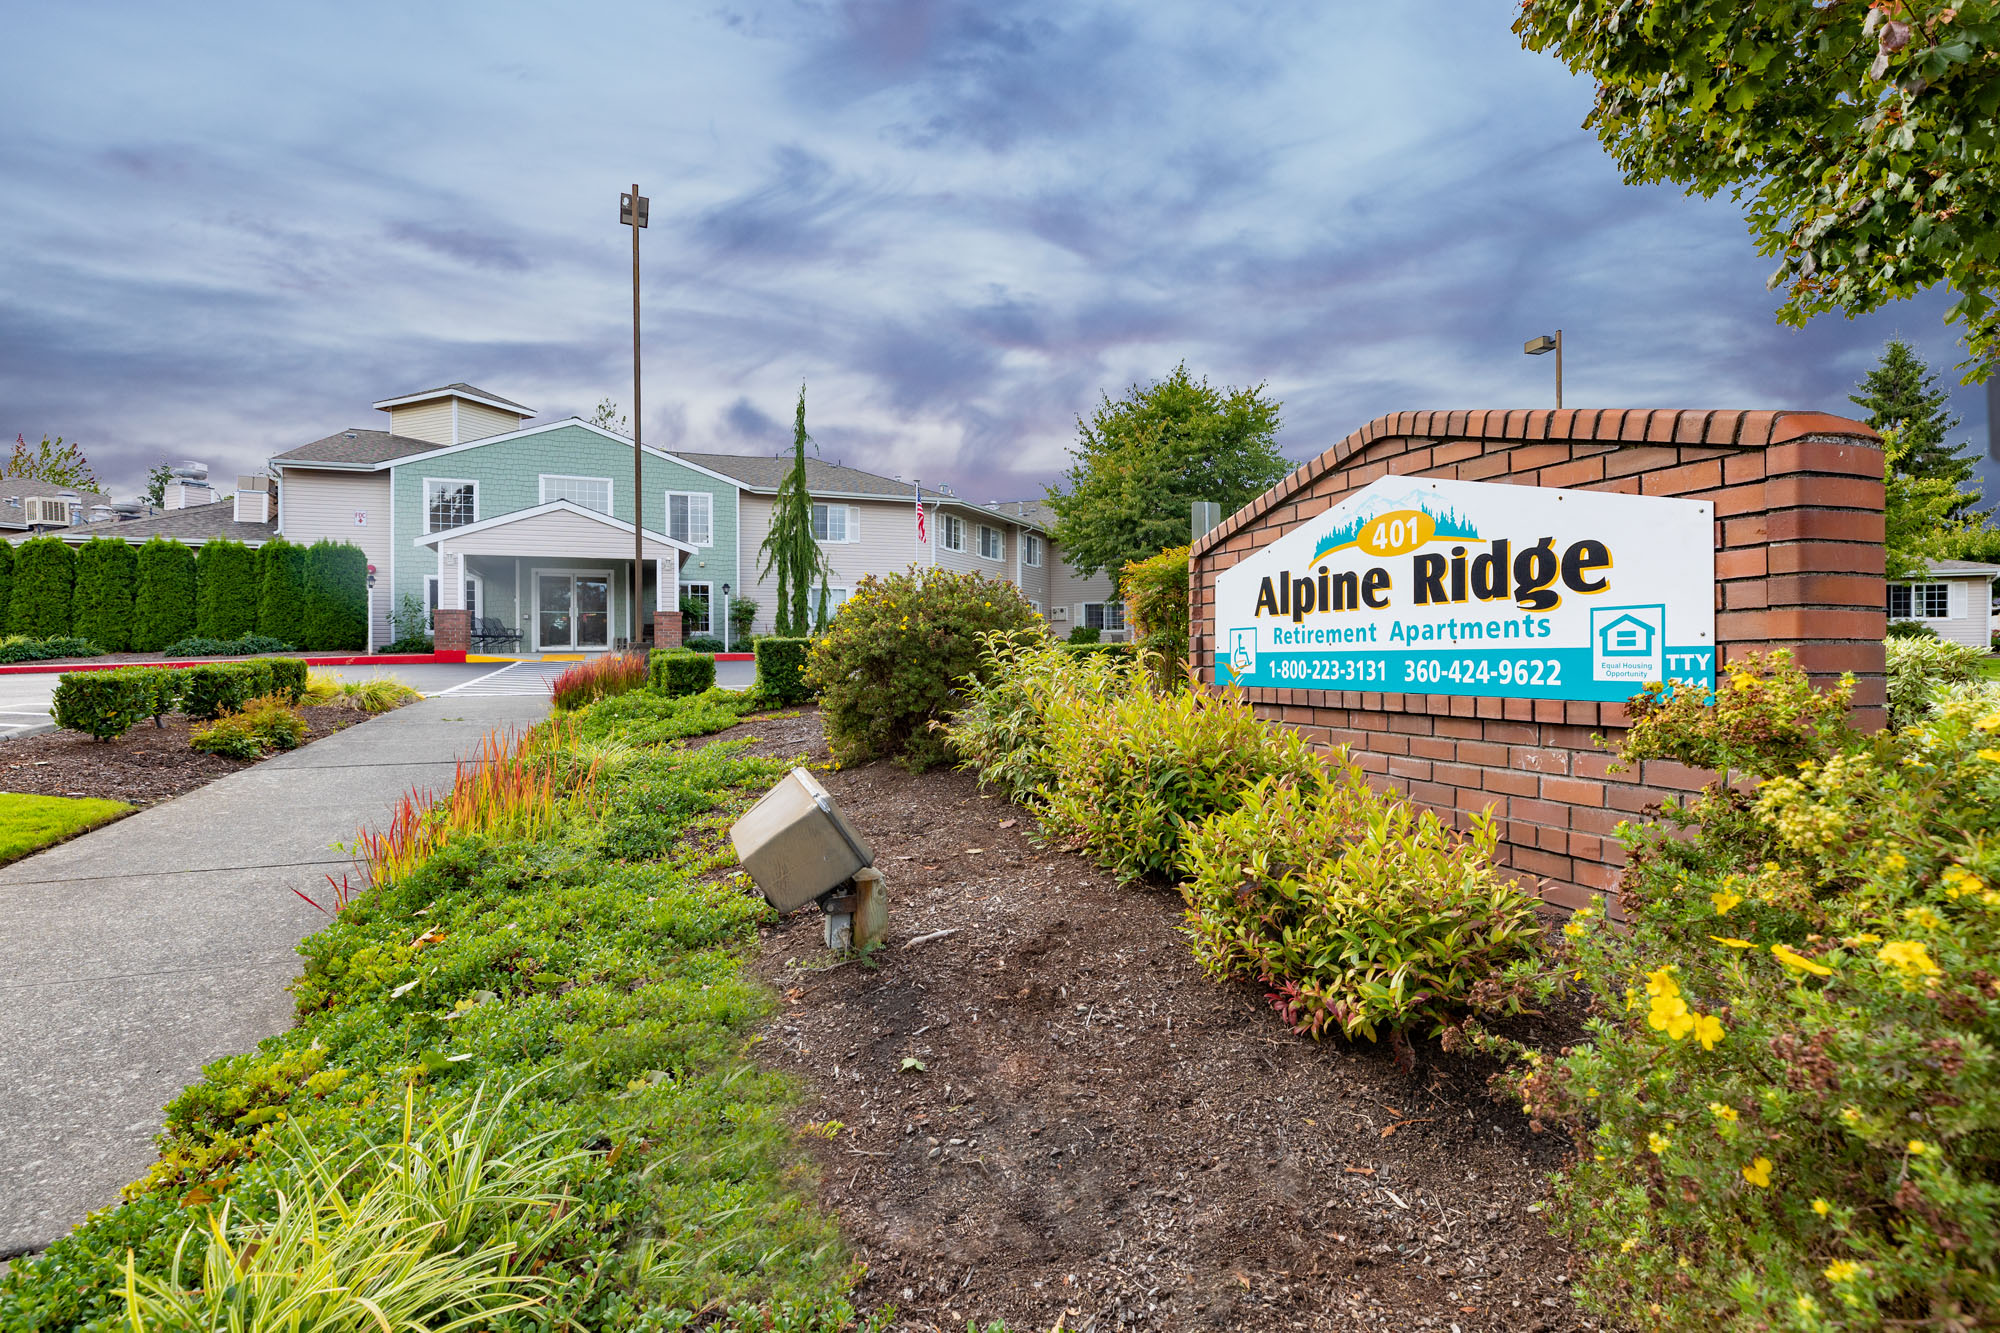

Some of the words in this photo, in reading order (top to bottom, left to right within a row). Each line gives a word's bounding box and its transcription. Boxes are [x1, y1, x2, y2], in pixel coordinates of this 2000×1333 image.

[1371, 516, 1419, 548] 401
[1254, 566, 1393, 624] Alpine
[1412, 536, 1614, 611] Ridge
[1273, 622, 1377, 645] Retirement
[1389, 614, 1551, 647] Apartments
[1268, 660, 1386, 681] 1-800-223-3131
[1404, 660, 1562, 686] 360-424-9622
[1601, 662, 1621, 671] Equal
[1622, 662, 1653, 672] Housing
[1605, 671, 1648, 679] Opportunity
[1665, 653, 1711, 671] TTY
